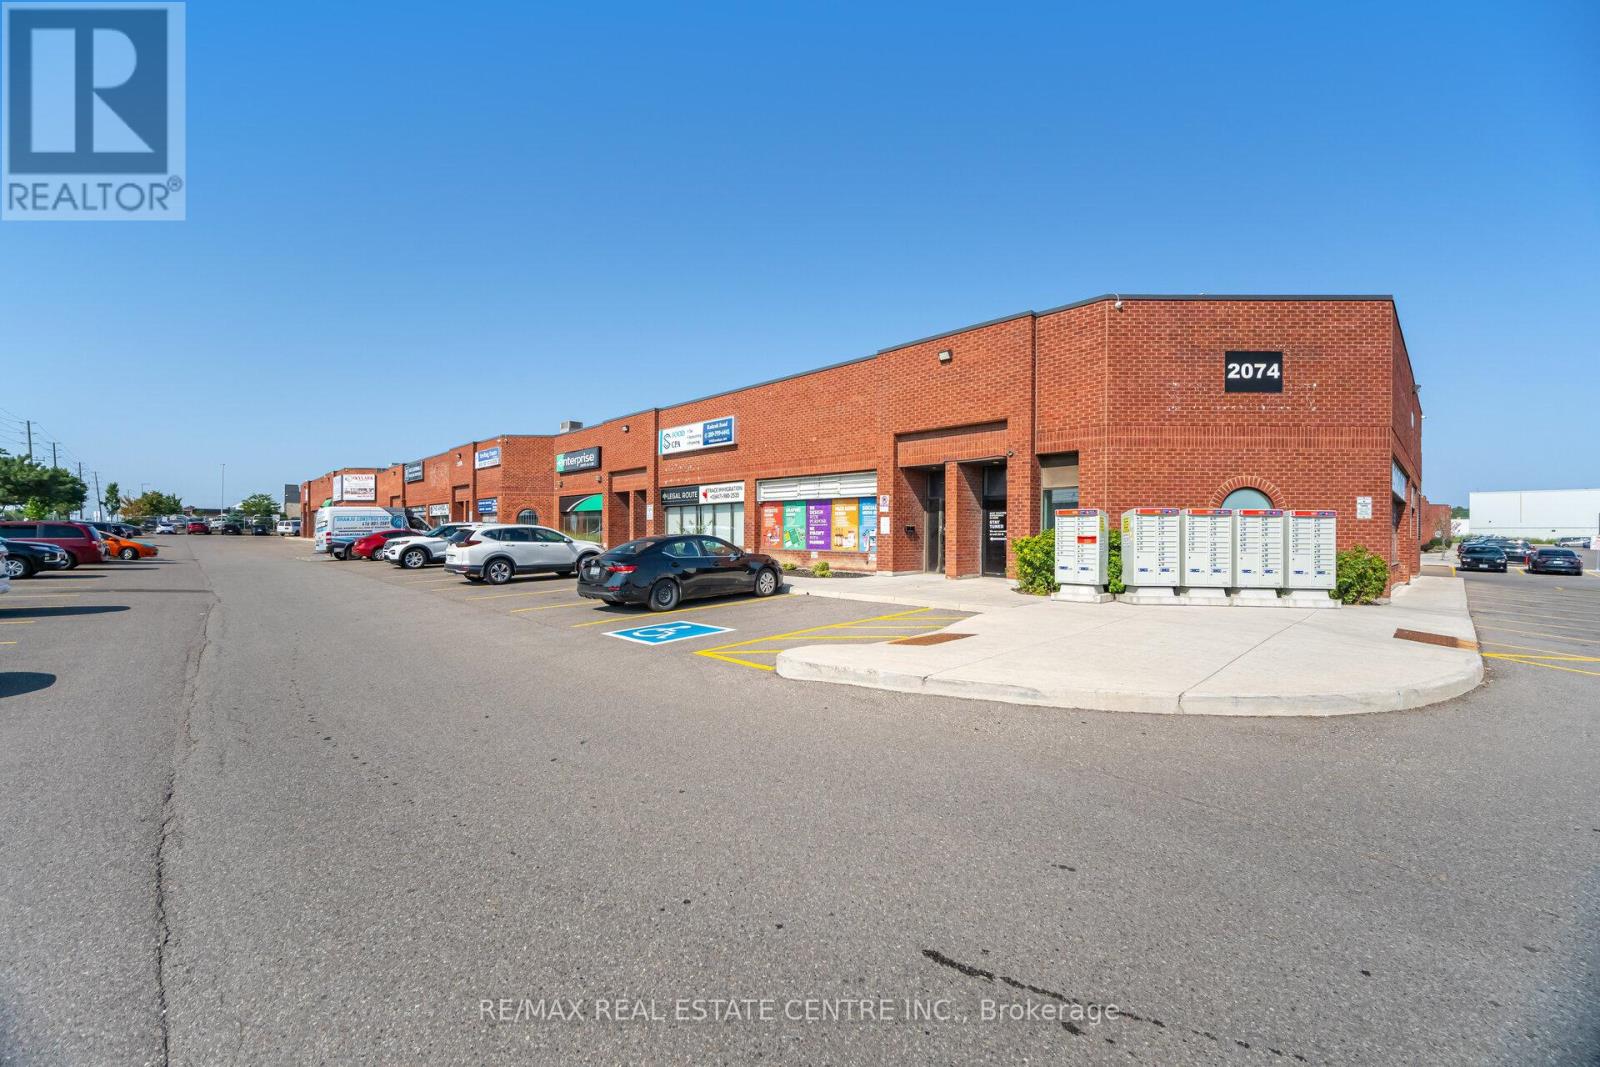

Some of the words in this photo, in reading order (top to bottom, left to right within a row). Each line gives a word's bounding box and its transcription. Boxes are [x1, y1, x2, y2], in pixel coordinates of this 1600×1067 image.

[1227, 363, 1281, 379] 2074
[556, 453, 595, 467] enterprise
[682, 491, 698, 499] ROUTE
